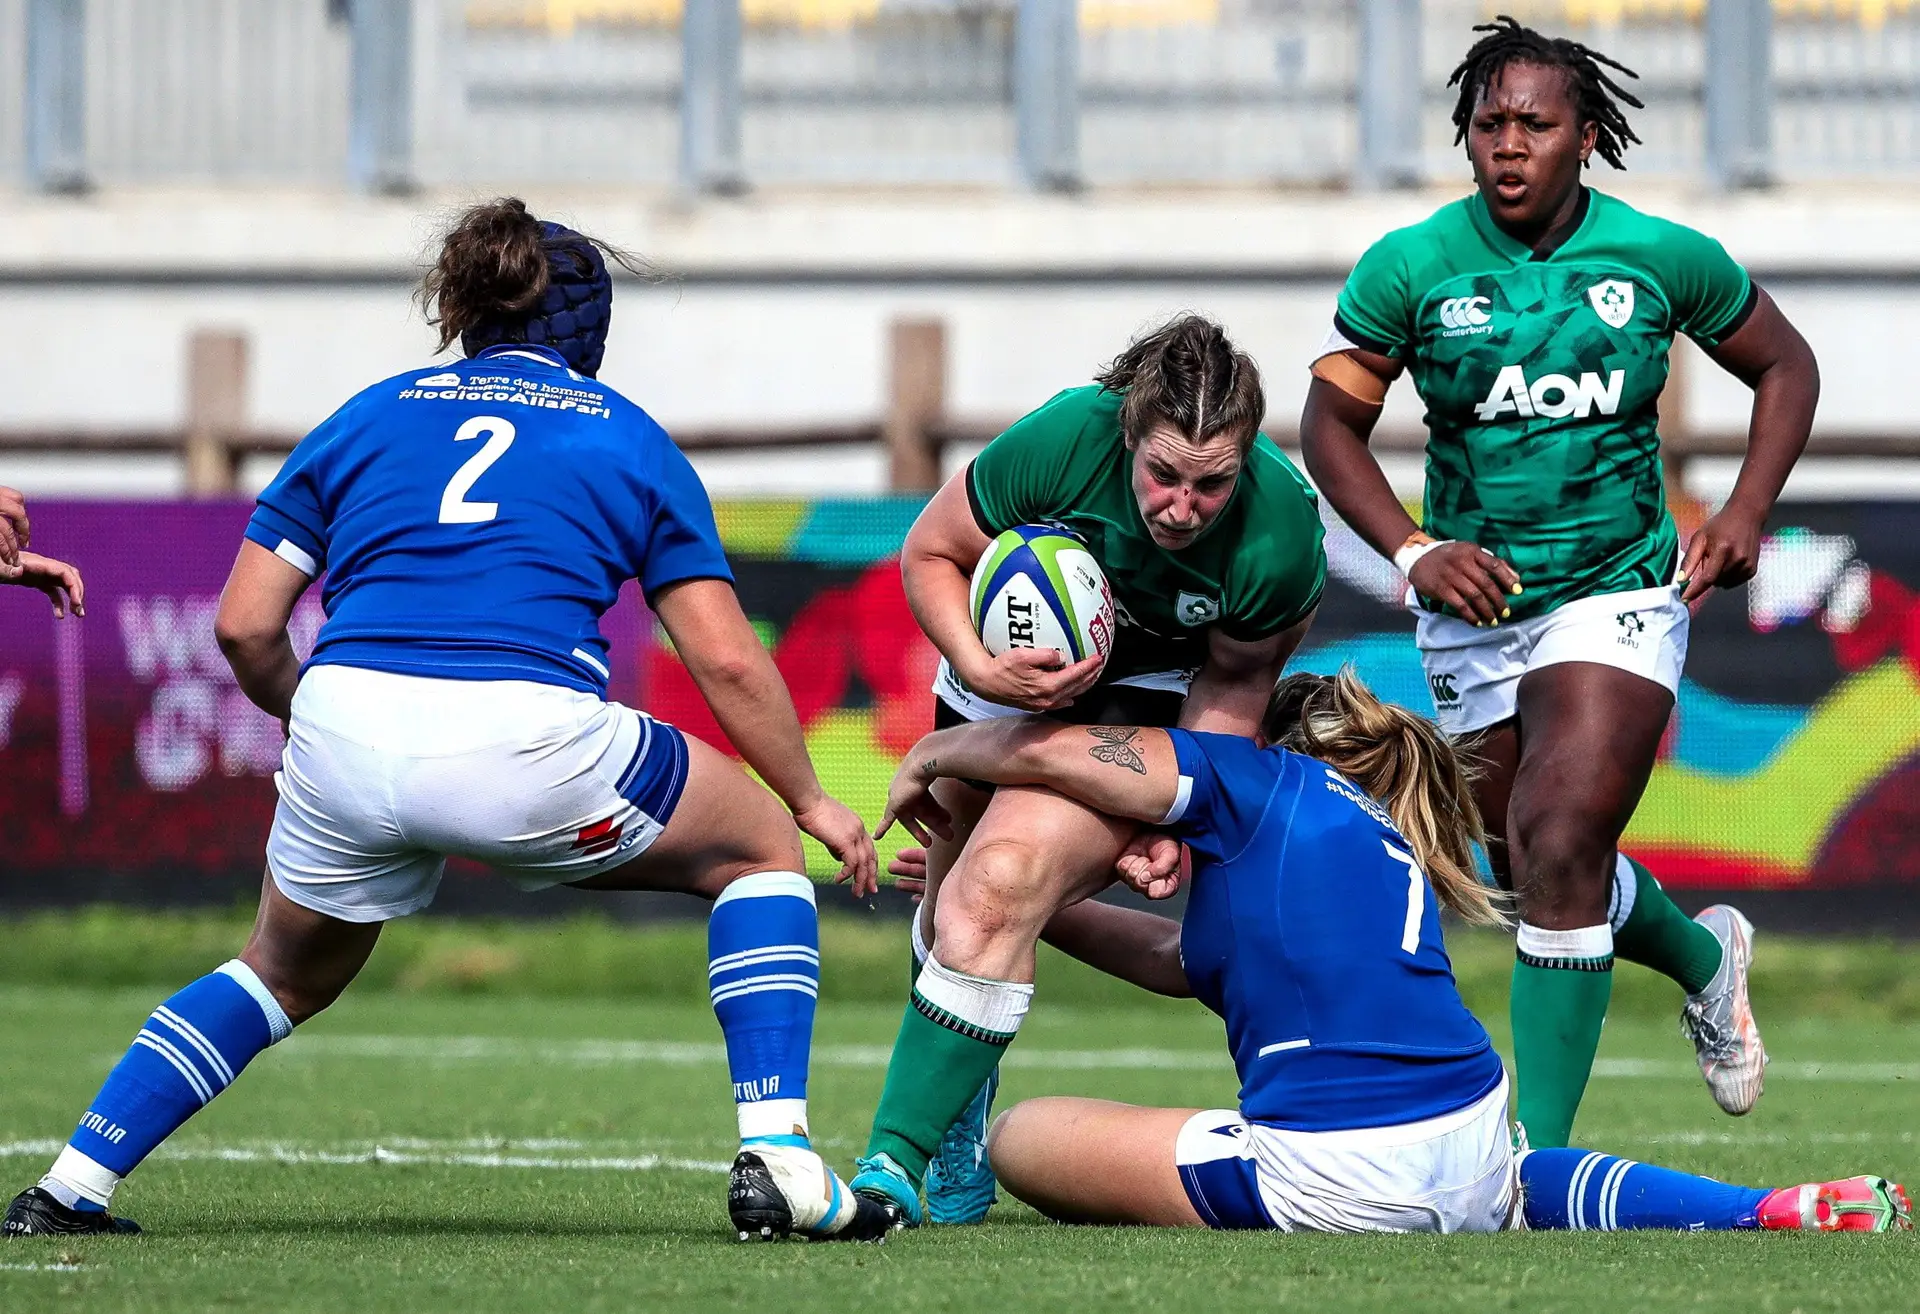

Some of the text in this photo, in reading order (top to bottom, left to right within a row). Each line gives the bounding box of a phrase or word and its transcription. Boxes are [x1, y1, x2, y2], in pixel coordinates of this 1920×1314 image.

[469, 376, 604, 401] Terre des hommes
[1474, 365, 1626, 421] AON
[438, 415, 516, 524] 2
[1007, 594, 1035, 650] RT
[1381, 838, 1424, 956] 7
[733, 1075, 780, 1102] ITALIA
[78, 1110, 127, 1145] ITALIA
[4, 1220, 33, 1234] COPA
